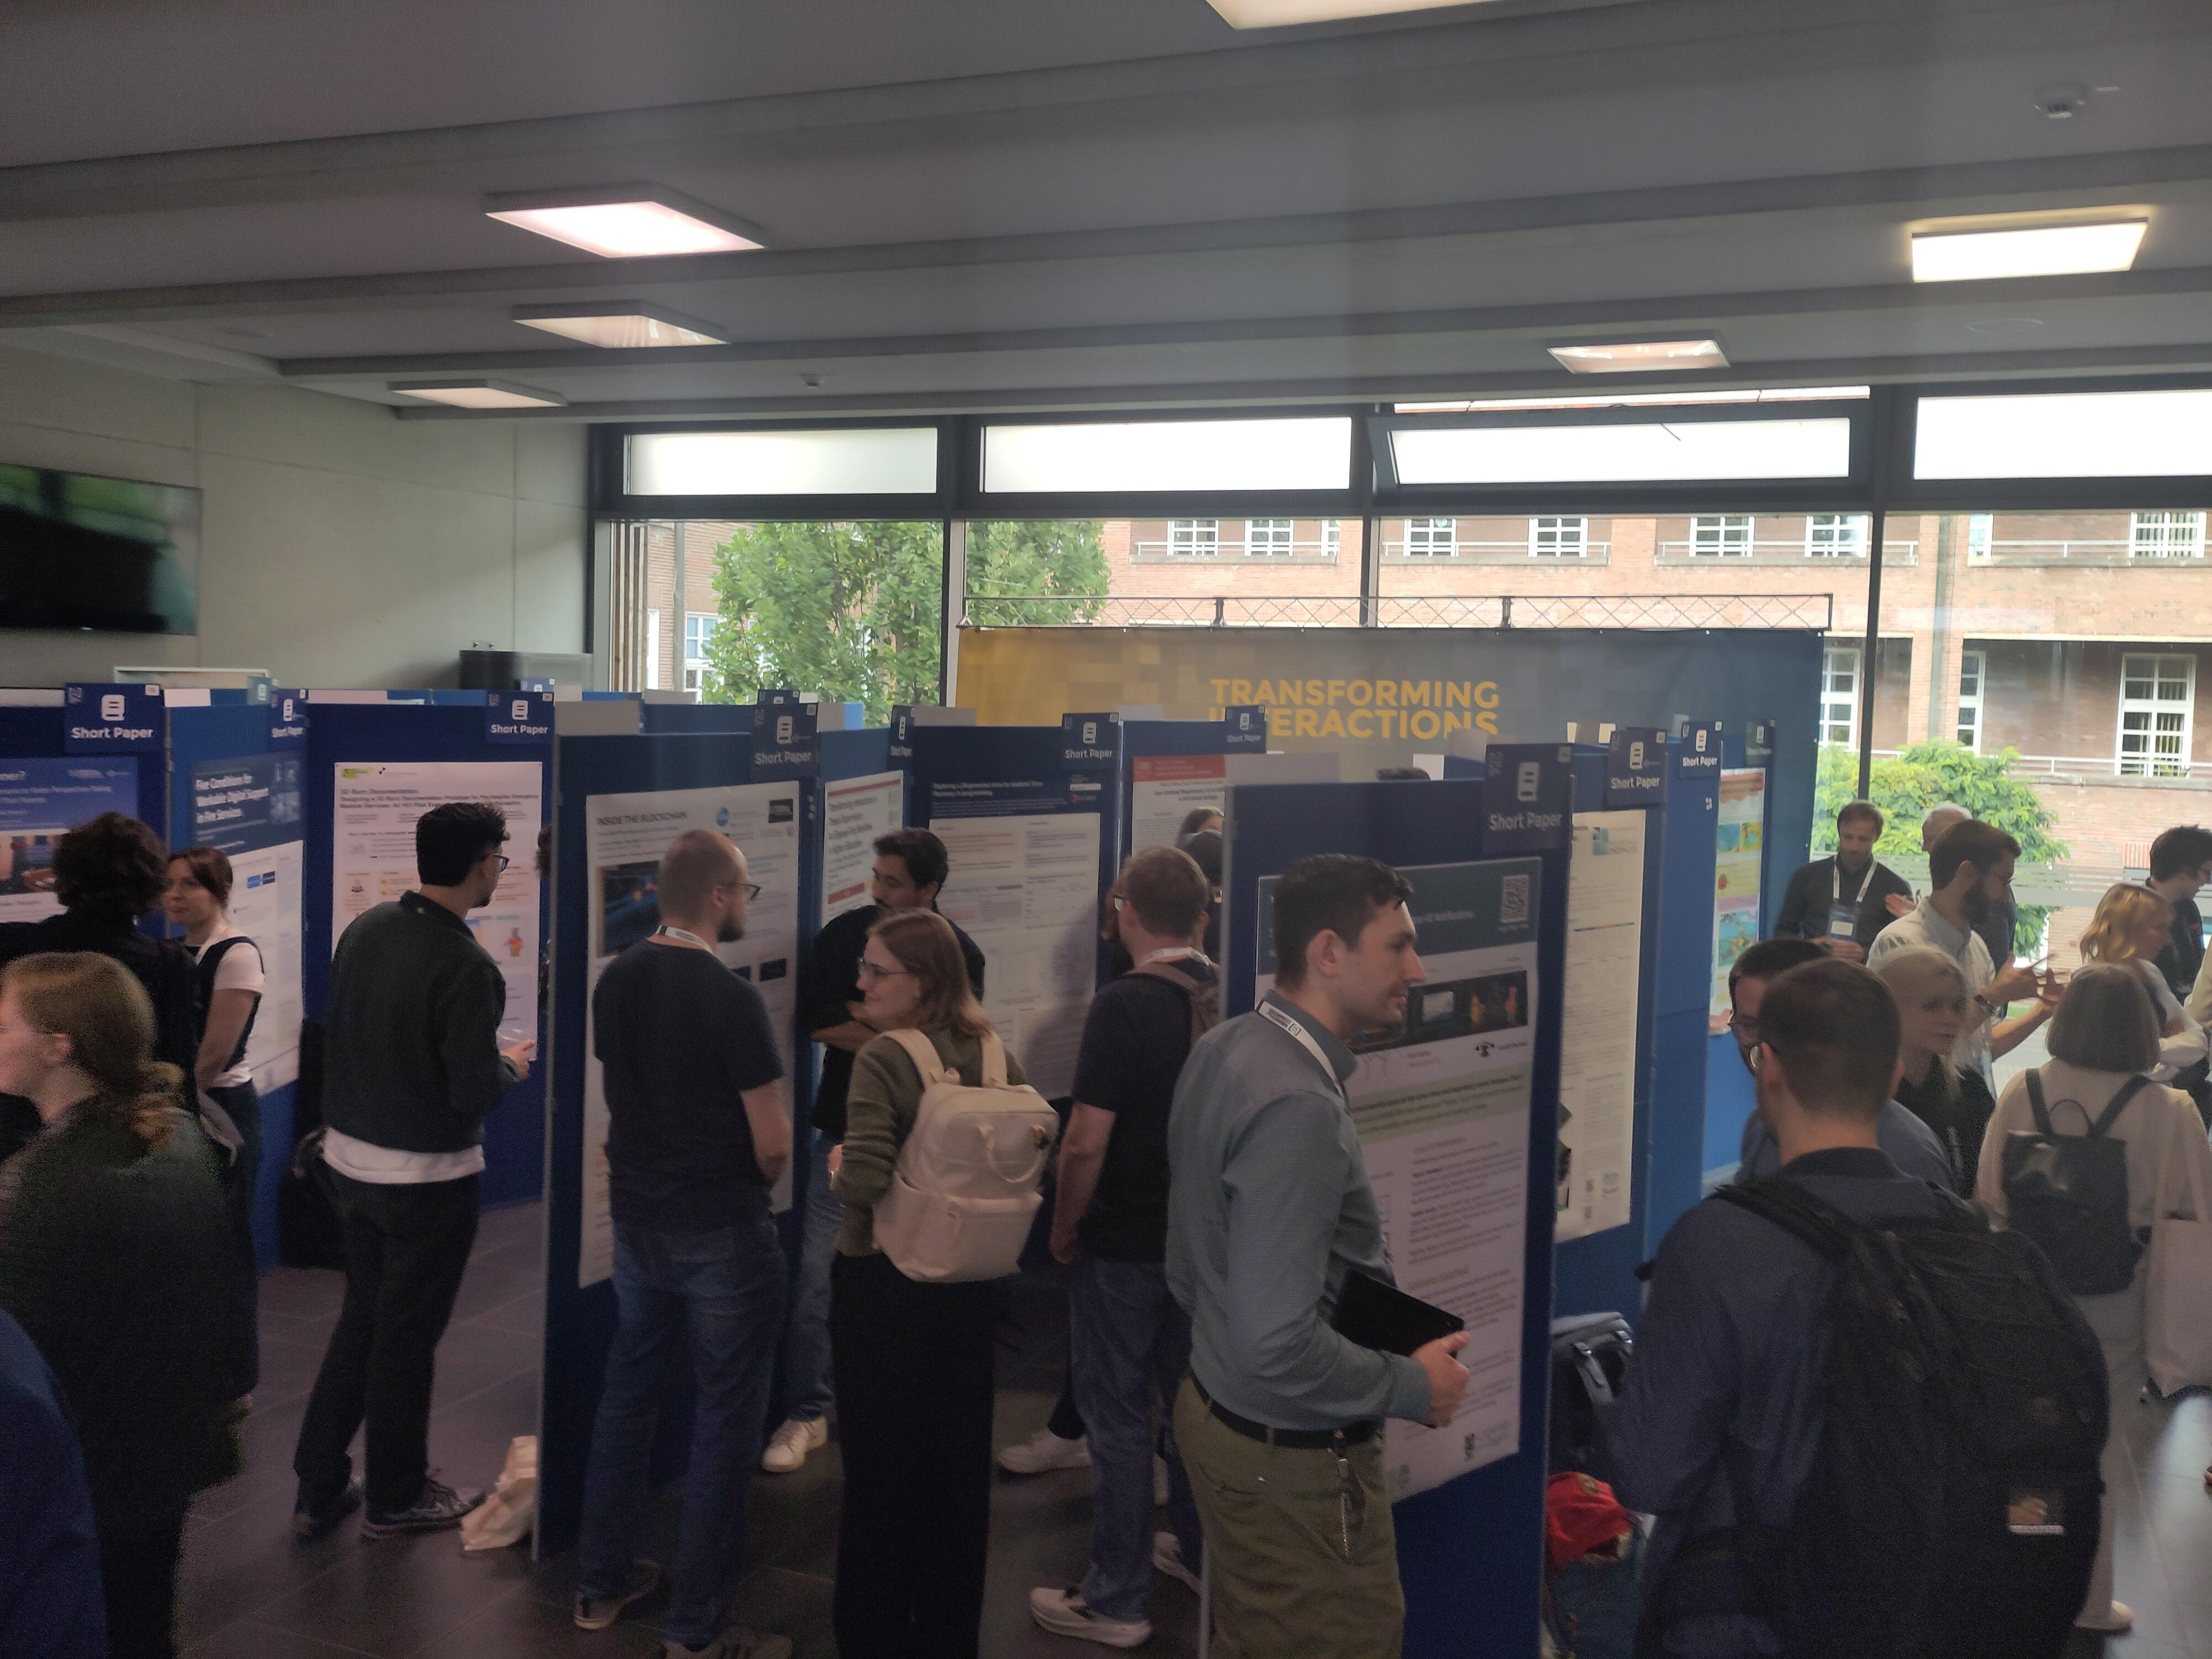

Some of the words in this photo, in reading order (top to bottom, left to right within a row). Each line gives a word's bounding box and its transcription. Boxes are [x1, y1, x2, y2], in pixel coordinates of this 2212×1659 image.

[1210, 679, 1499, 708] TRANSFORMING
[491, 724, 518, 733] Short
[520, 724, 548, 735] Paper
[1209, 707, 1498, 739] ERACTIONS
[71, 727, 111, 739] Short
[113, 727, 154, 740] Paper
[755, 752, 782, 765] Short
[785, 751, 812, 764] Paper
[1065, 749, 1088, 759] Short
[1089, 749, 1112, 760] Paper
[1683, 756, 1699, 766] Short
[1700, 755, 1718, 768] Paper
[1611, 776, 1634, 789] Short
[1636, 776, 1660, 790] Paper
[597, 816, 623, 826] INSIDE
[624, 815, 639, 823] THE
[640, 811, 687, 822] BLOCKCHAIN
[1489, 813, 1525, 831] Short
[1527, 812, 1562, 831] Paper
